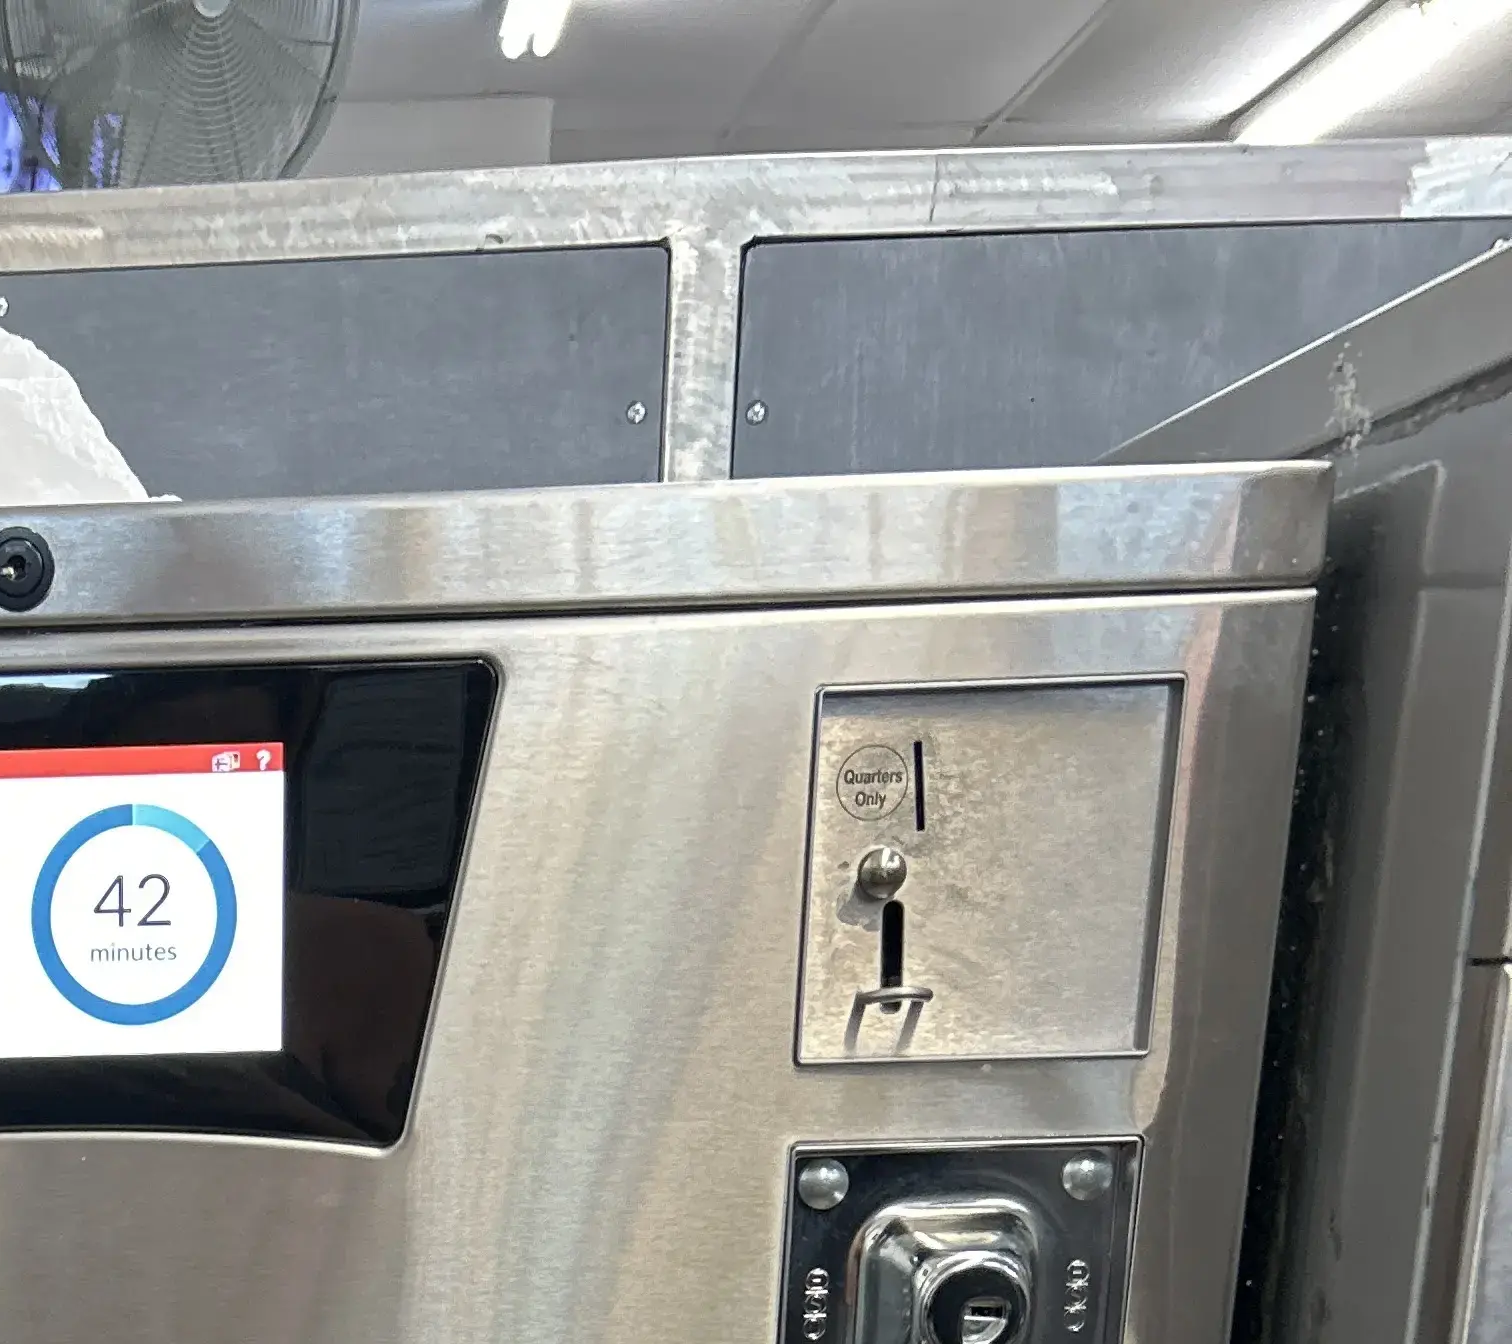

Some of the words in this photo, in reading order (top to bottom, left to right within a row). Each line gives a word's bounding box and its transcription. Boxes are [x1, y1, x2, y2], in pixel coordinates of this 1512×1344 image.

[843, 769, 903, 785] Quarters
[855, 791, 886, 810] Only
[93, 873, 172, 927] 42
[90, 943, 177, 962] minutes
